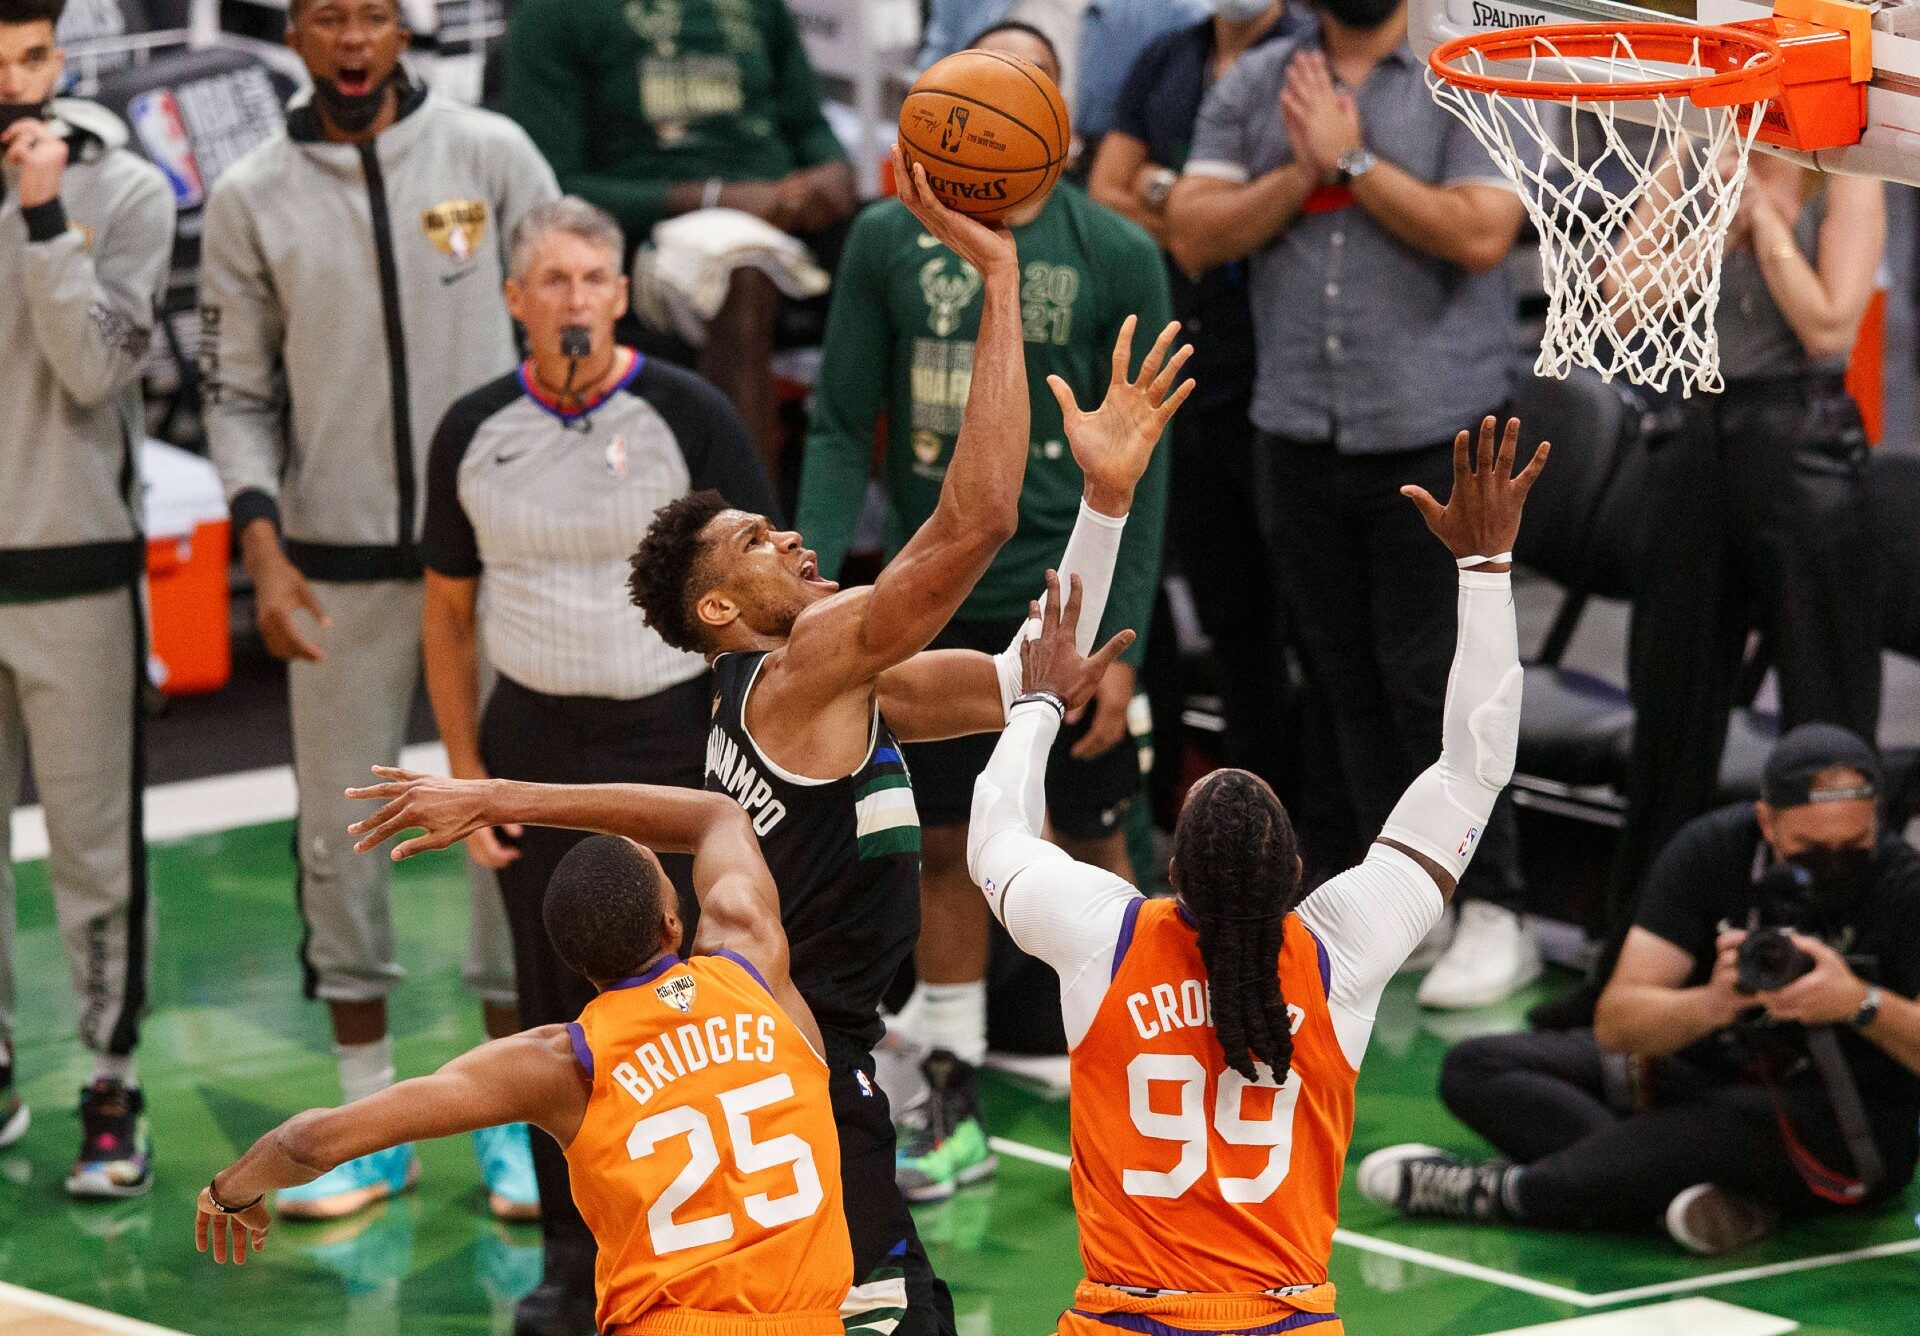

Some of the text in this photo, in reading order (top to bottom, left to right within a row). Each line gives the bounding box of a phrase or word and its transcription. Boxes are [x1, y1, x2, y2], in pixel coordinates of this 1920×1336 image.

[1021, 260, 1080, 306] 20
[1023, 301, 1072, 346] 21
[671, 976, 694, 992] FINALS
[611, 1013, 776, 1106] BRIDGES
[1122, 1052, 1302, 1204] 99
[626, 1072, 824, 1256] 25
